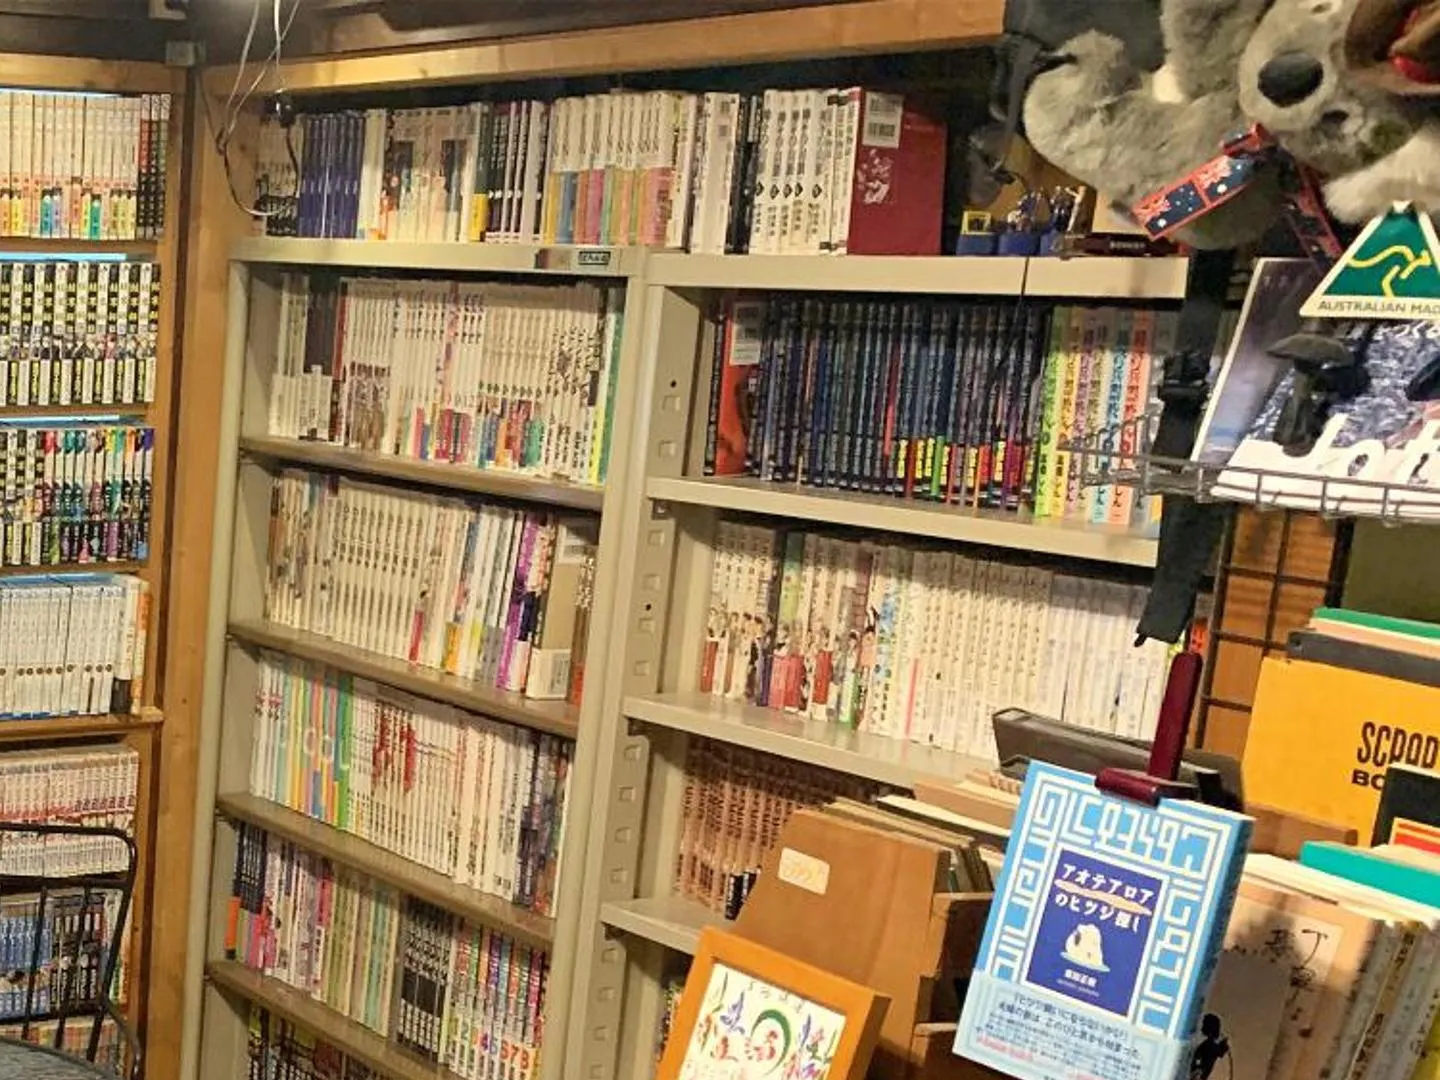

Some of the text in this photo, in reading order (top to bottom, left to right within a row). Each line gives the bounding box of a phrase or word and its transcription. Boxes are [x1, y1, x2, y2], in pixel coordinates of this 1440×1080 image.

[1317, 300, 1406, 313] AUSTRALIAN
[1062, 863, 1155, 905] アオテアロア
